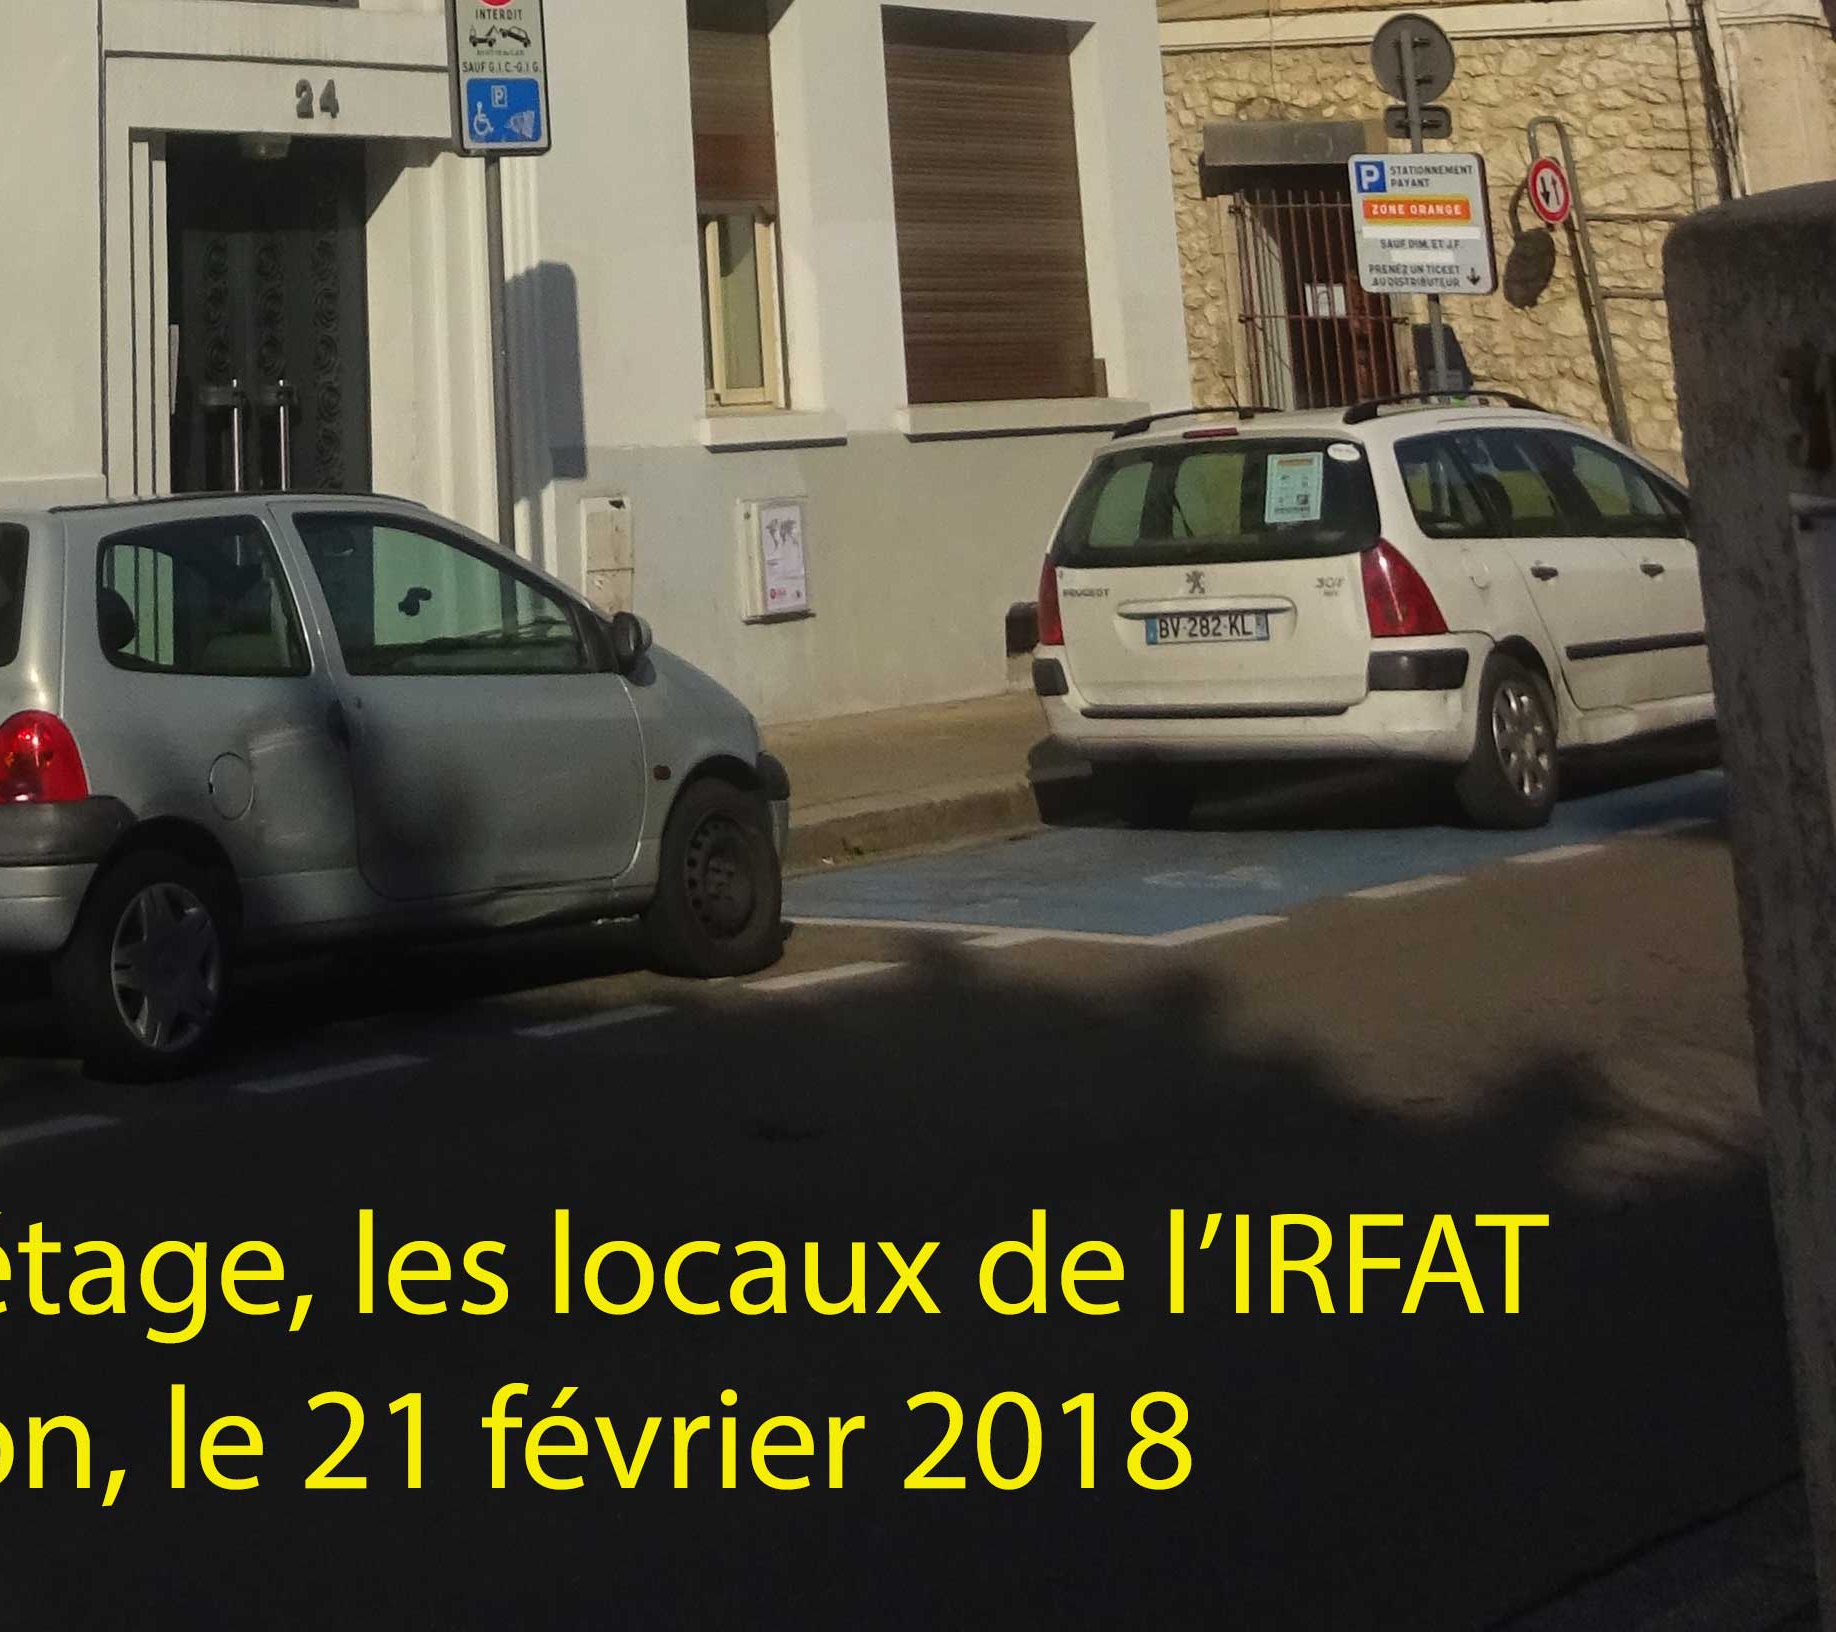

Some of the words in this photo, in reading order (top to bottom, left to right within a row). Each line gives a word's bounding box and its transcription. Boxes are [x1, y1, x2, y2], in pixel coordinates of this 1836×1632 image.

[475, 9, 523, 21] INTERDIT
[462, 61, 486, 73] SAUF
[296, 79, 339, 119] 24
[1390, 165, 1473, 176] STATIONNEMENT
[1360, 164, 1380, 190] P
[1391, 178, 1430, 188] PAYANT
[1371, 204, 1405, 216] ZONE
[1410, 204, 1462, 216] ORANGE
[1410, 264, 1424, 274] UN
[1426, 264, 1460, 274] TICKET
[1387, 277, 1460, 288] DISTRIBUTEUR
